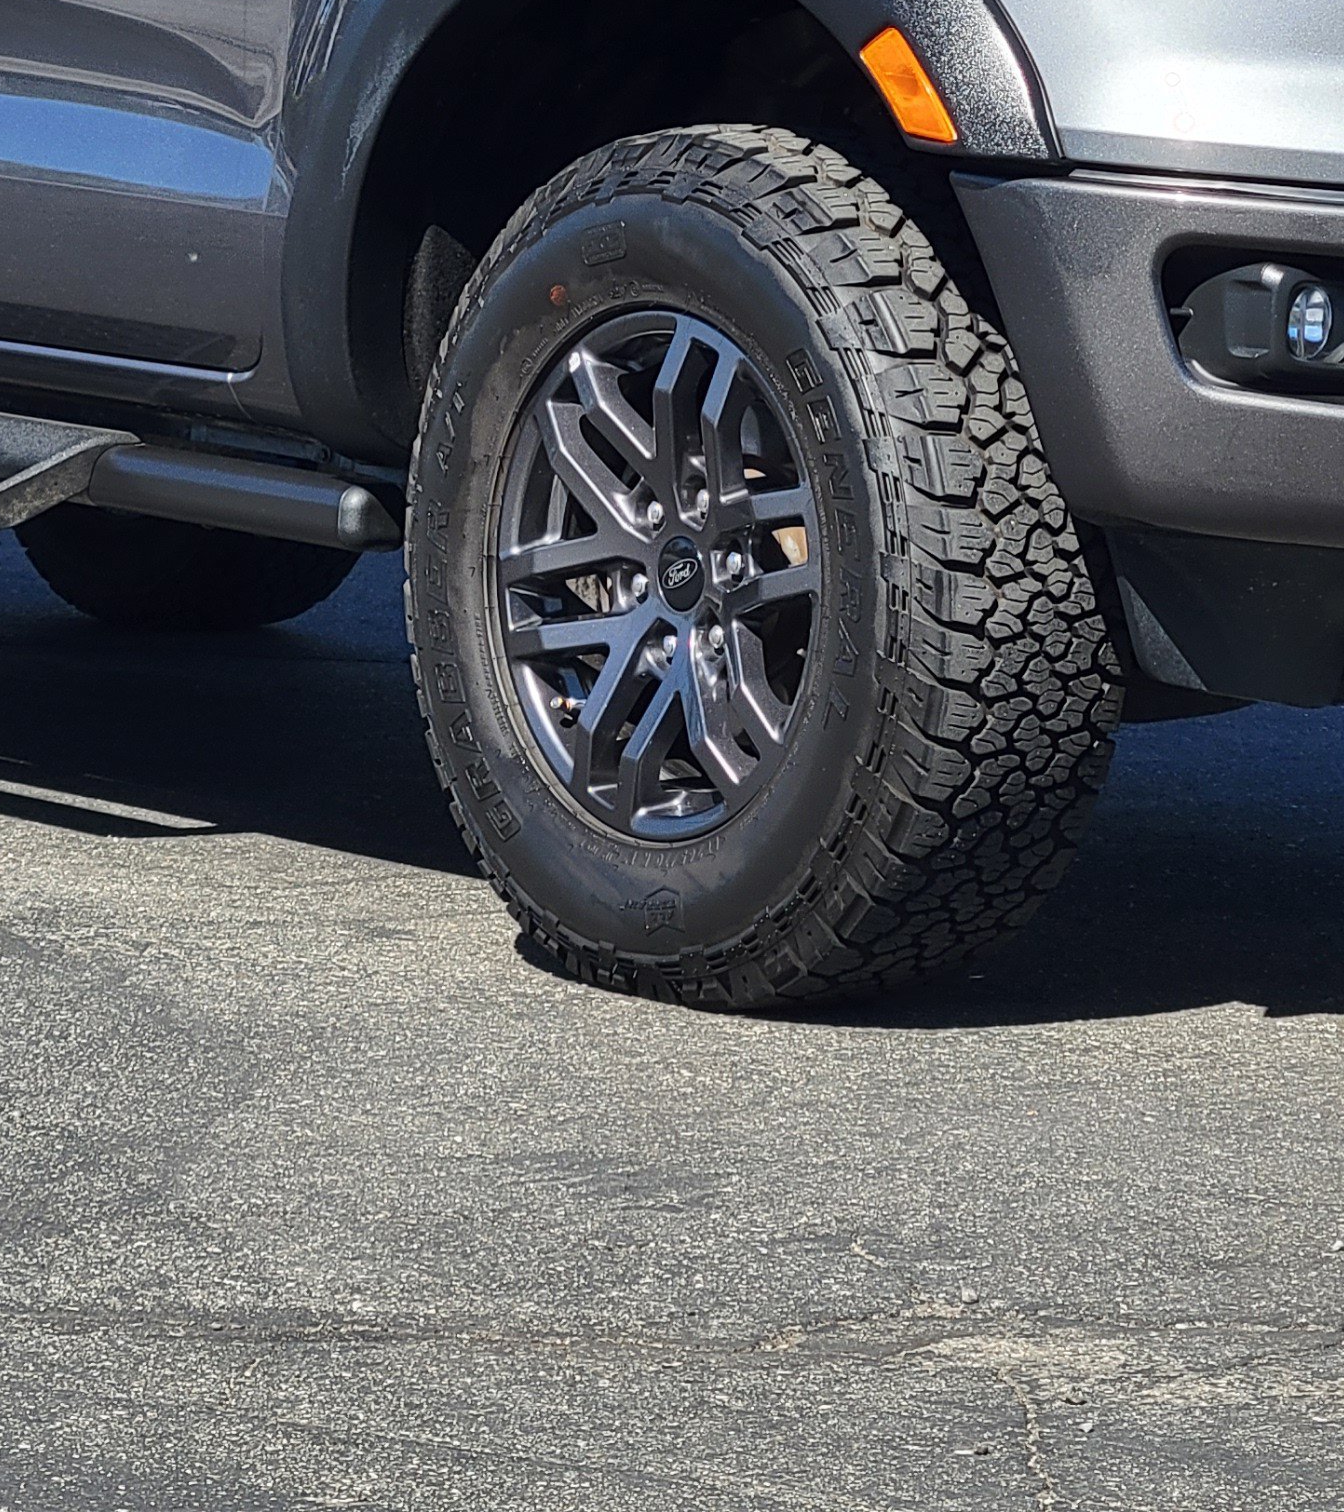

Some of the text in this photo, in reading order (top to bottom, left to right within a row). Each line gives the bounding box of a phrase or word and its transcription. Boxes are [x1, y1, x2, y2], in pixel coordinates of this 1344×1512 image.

[423, 498, 522, 842] GRABBER
[668, 563, 690, 586] Ford
[784, 347, 862, 731] GENERAL
